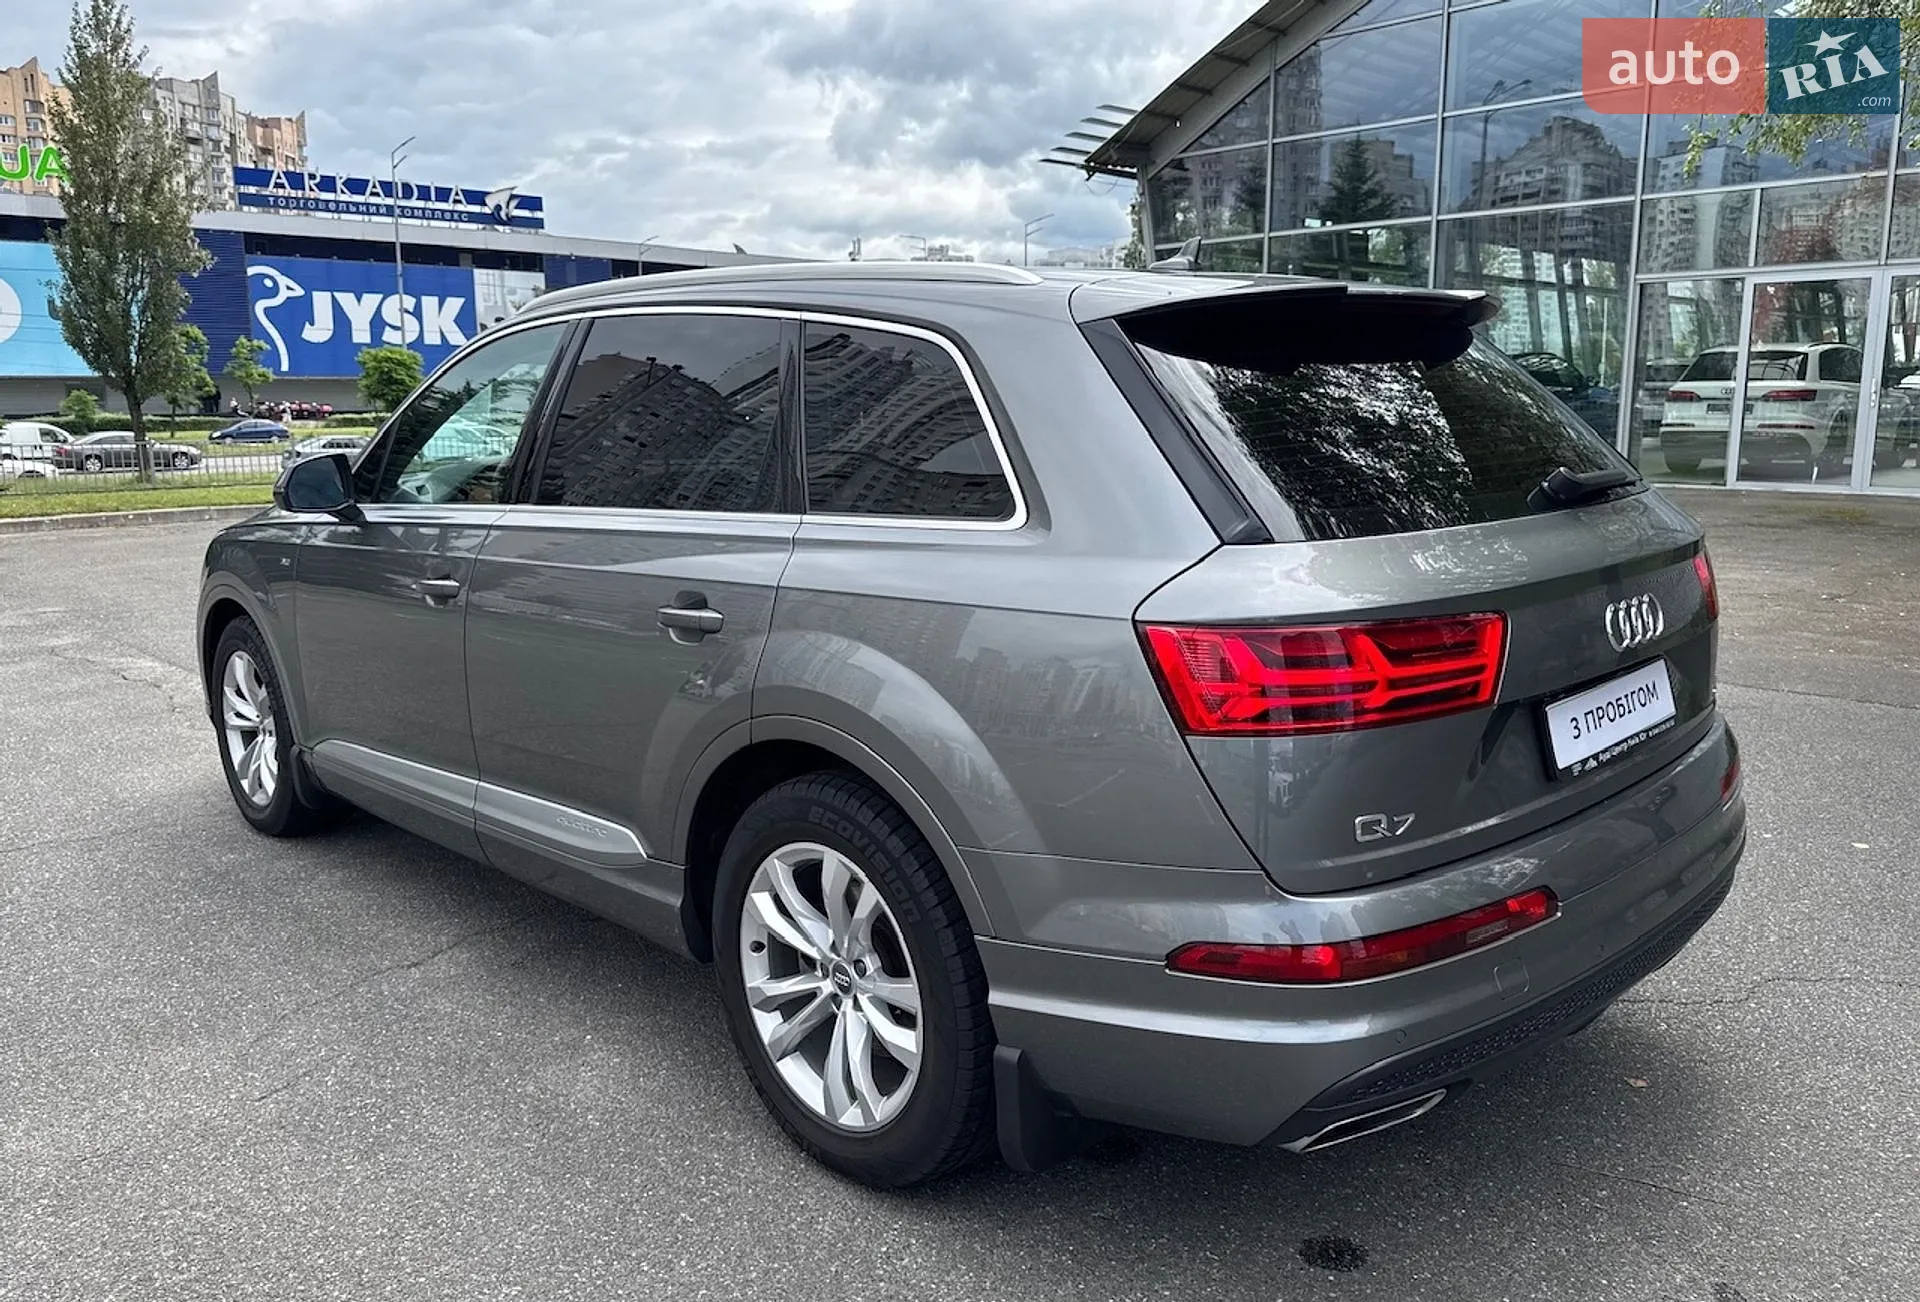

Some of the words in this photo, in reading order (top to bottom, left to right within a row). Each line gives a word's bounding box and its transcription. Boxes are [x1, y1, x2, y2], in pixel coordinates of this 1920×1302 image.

[267, 166, 468, 208] ARKADIA
[395, 204, 470, 222] комплекс
[301, 290, 468, 345] JYSK
[1583, 680, 1659, 734] ПРОБІГОМ
[1354, 812, 1416, 842] Q7
